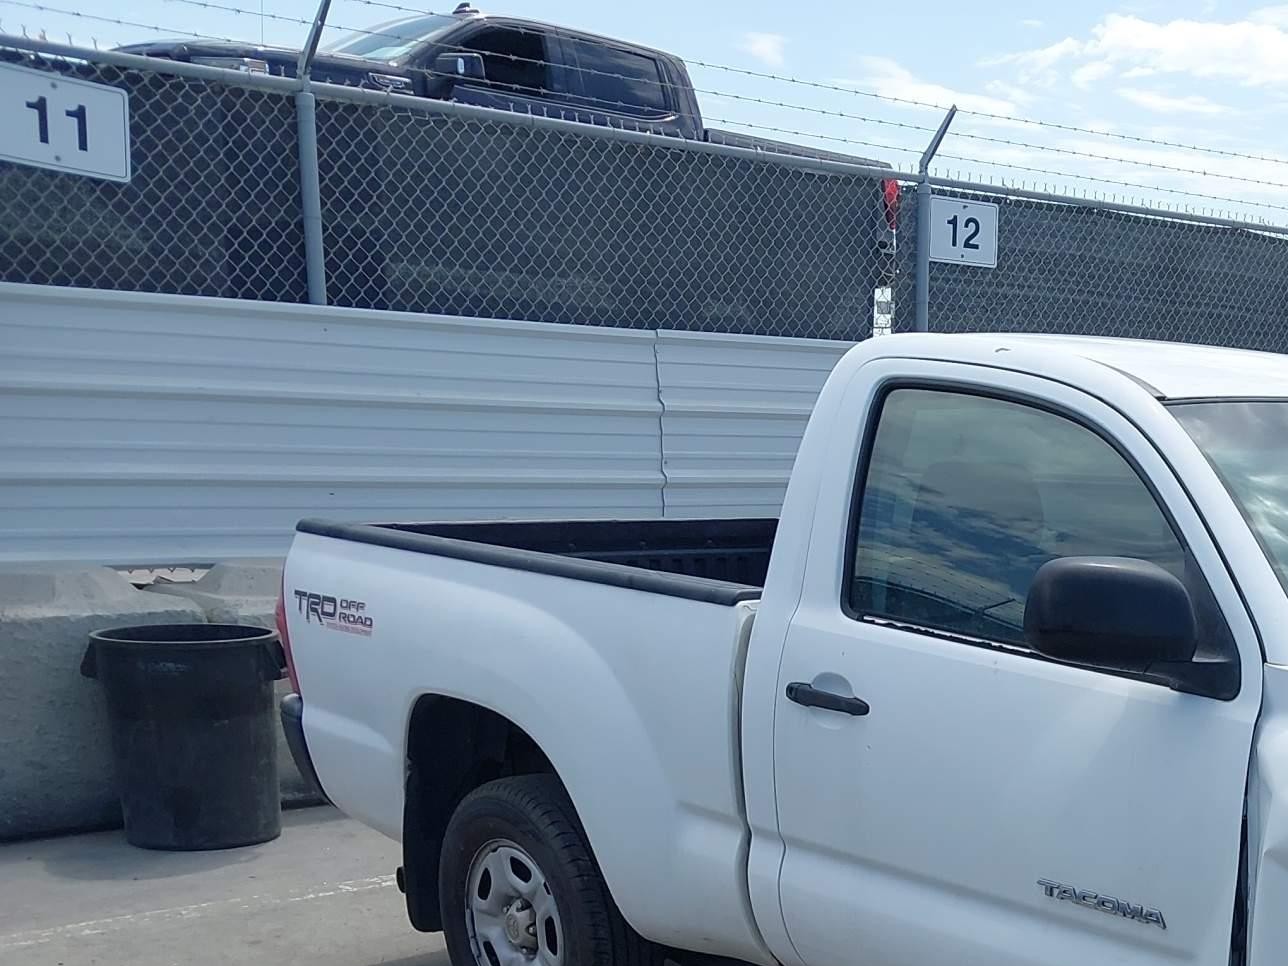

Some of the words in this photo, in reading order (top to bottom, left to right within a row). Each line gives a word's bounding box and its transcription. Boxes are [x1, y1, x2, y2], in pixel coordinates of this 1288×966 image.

[25, 95, 89, 153] 11
[946, 214, 980, 250] 12
[294, 589, 337, 624] TRD
[338, 612, 373, 628] ROAD
[340, 599, 366, 612] OFF
[1037, 877, 1167, 930] TACOMA
